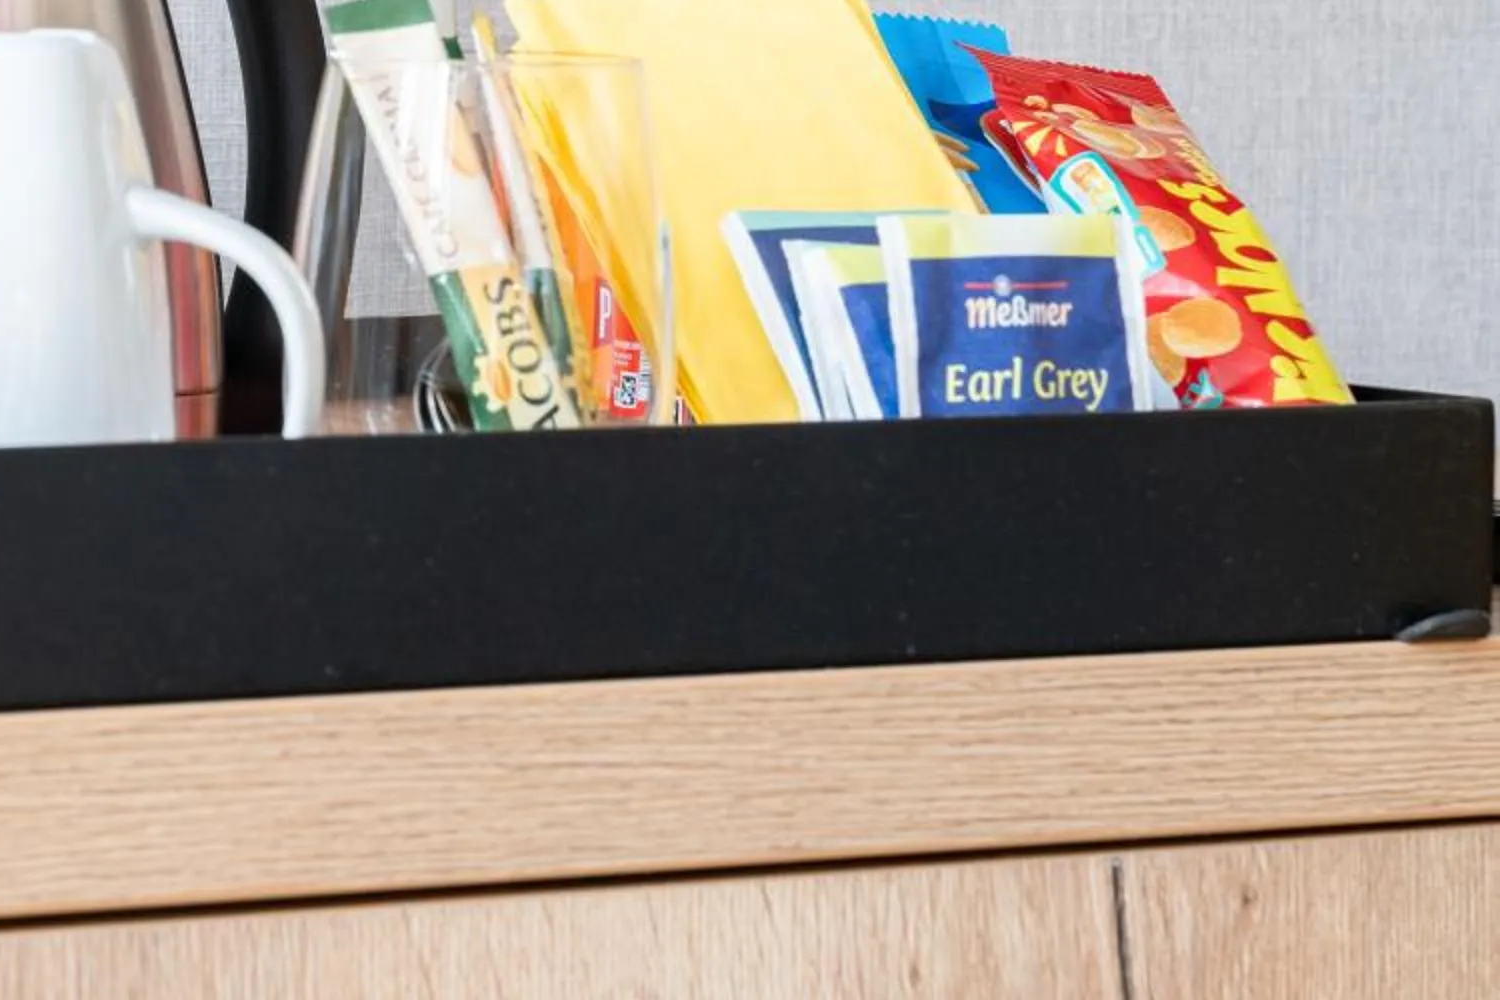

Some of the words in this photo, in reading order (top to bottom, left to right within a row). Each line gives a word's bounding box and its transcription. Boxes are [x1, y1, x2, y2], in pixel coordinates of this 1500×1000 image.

[964, 295, 1073, 329] Meßmer
[945, 355, 1023, 403] Earl
[1033, 359, 1109, 412] Grey
